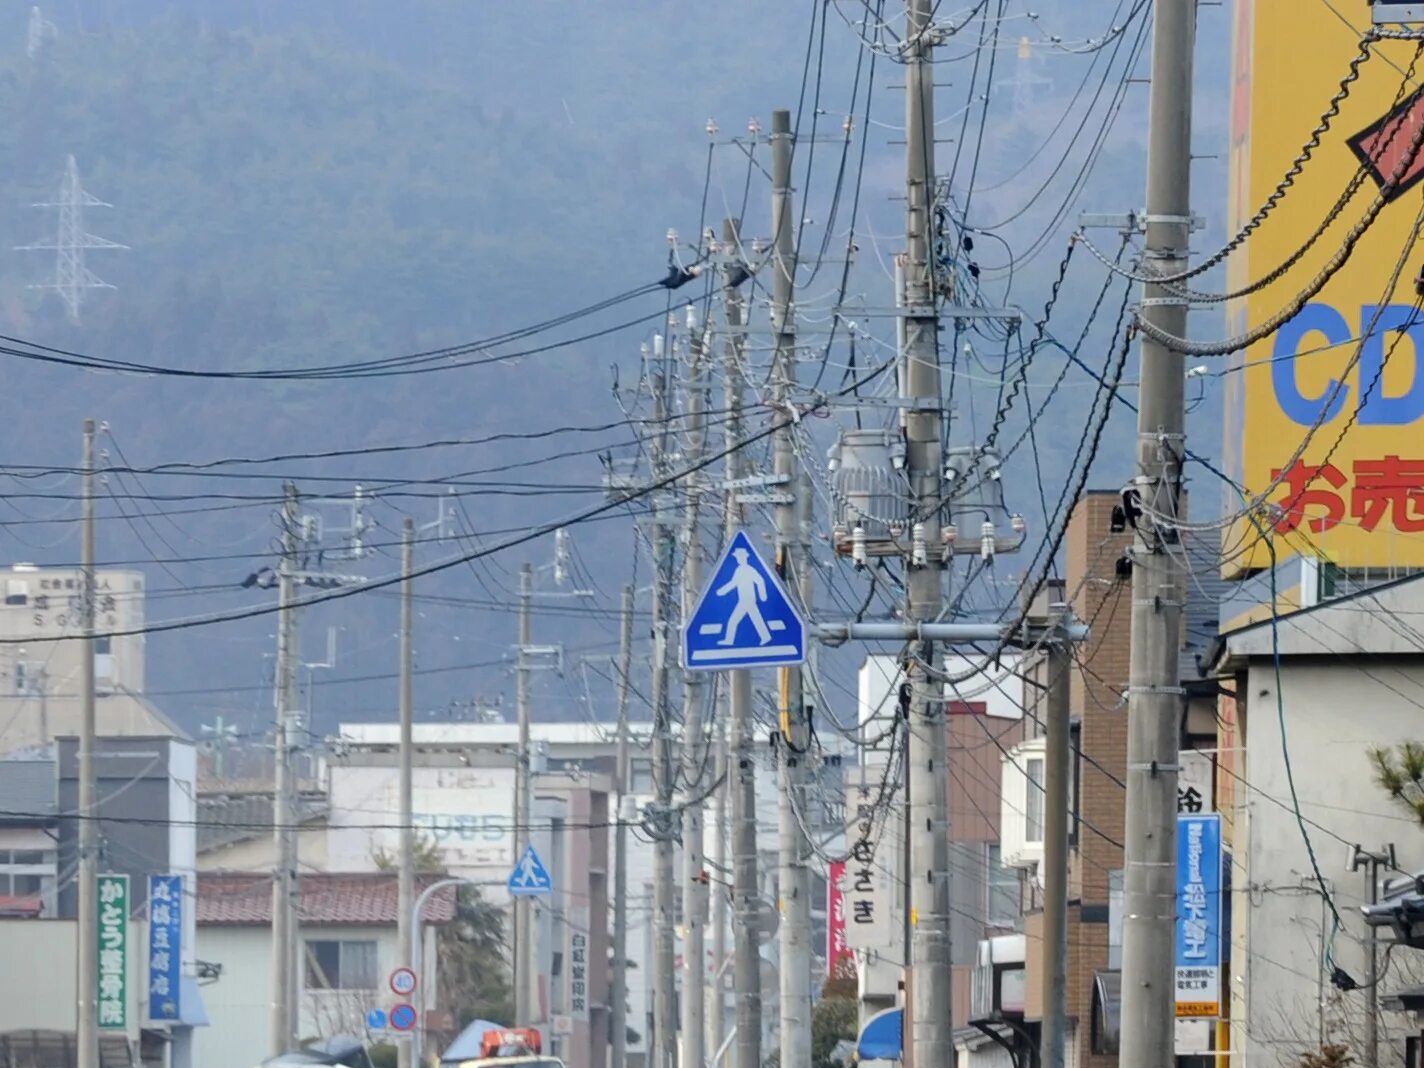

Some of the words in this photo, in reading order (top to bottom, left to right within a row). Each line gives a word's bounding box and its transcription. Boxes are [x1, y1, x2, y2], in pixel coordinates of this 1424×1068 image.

[1271, 303, 1424, 427] CD
[99, 879, 124, 1025] かとう整骨院
[1182, 883, 1208, 959] 松下電工
